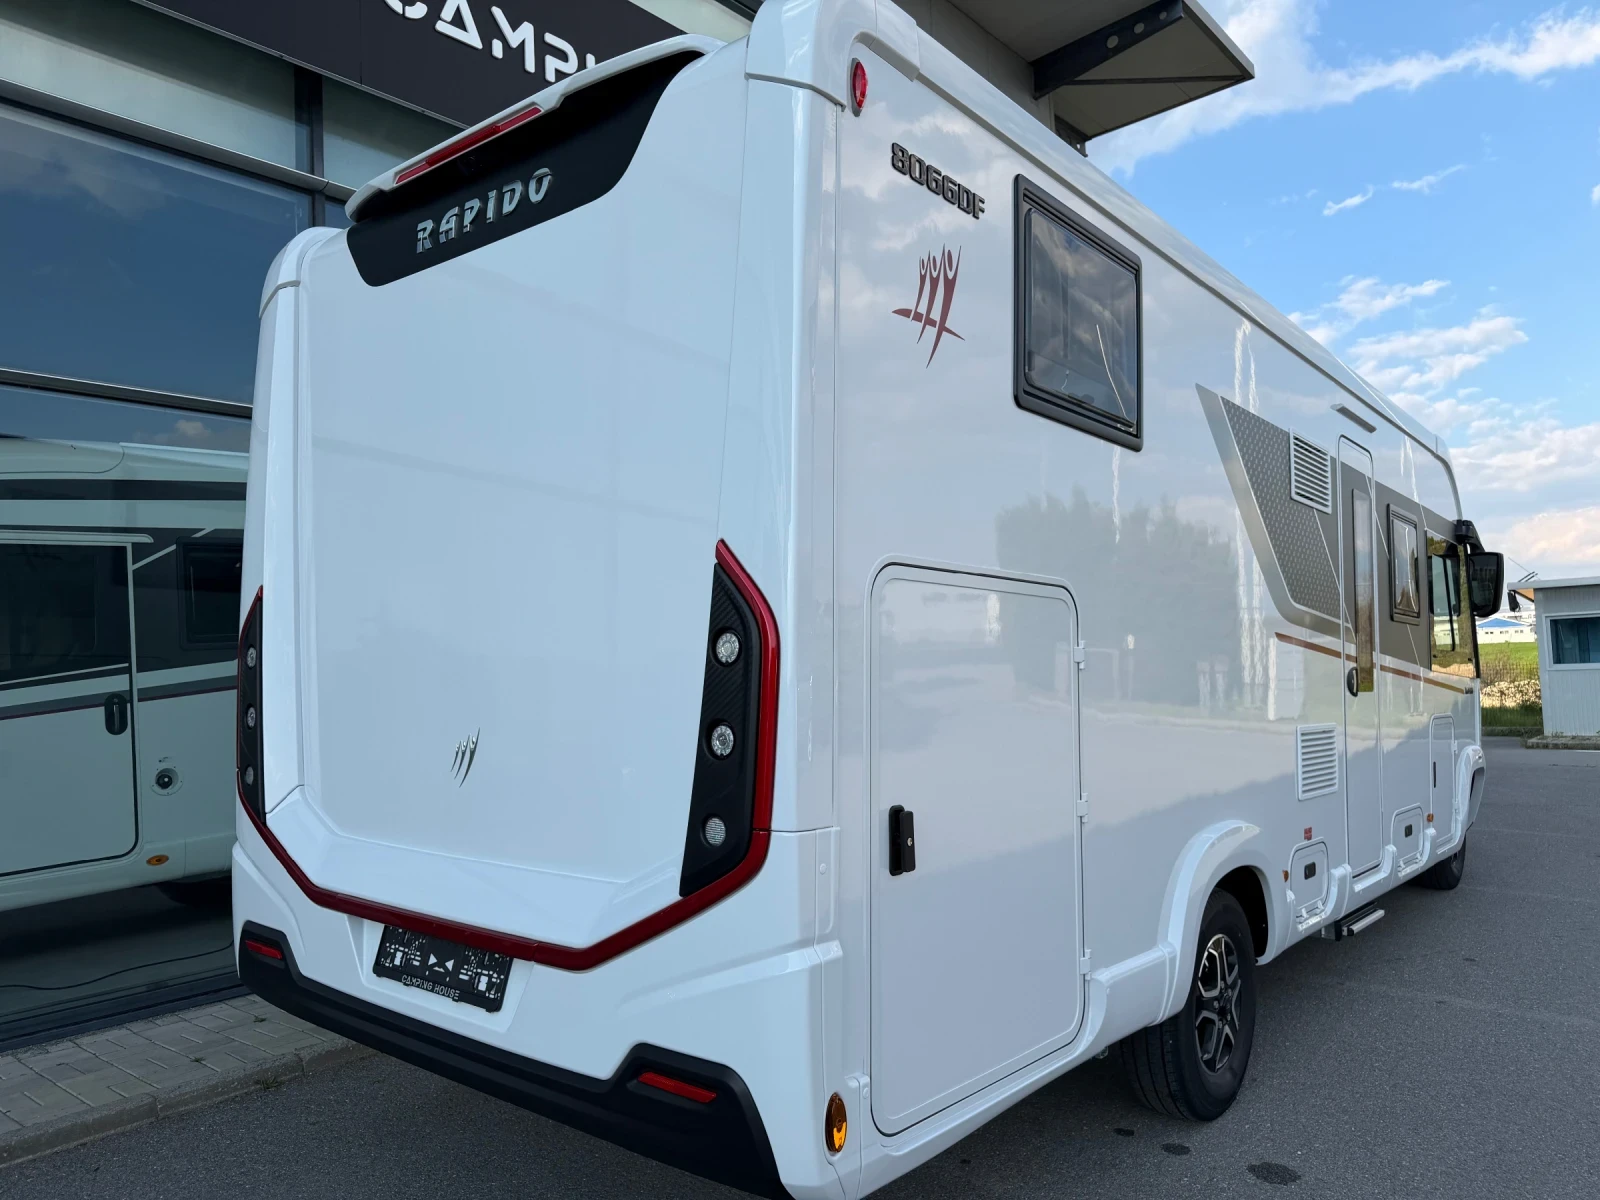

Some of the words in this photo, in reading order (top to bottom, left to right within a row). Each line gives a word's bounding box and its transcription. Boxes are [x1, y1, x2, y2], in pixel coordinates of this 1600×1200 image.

[416, 167, 553, 254] RAPIDO
[891, 142, 986, 220] 8066DF
[401, 974, 433, 990] CAMPING
[433, 983, 461, 1000] HOUSE
